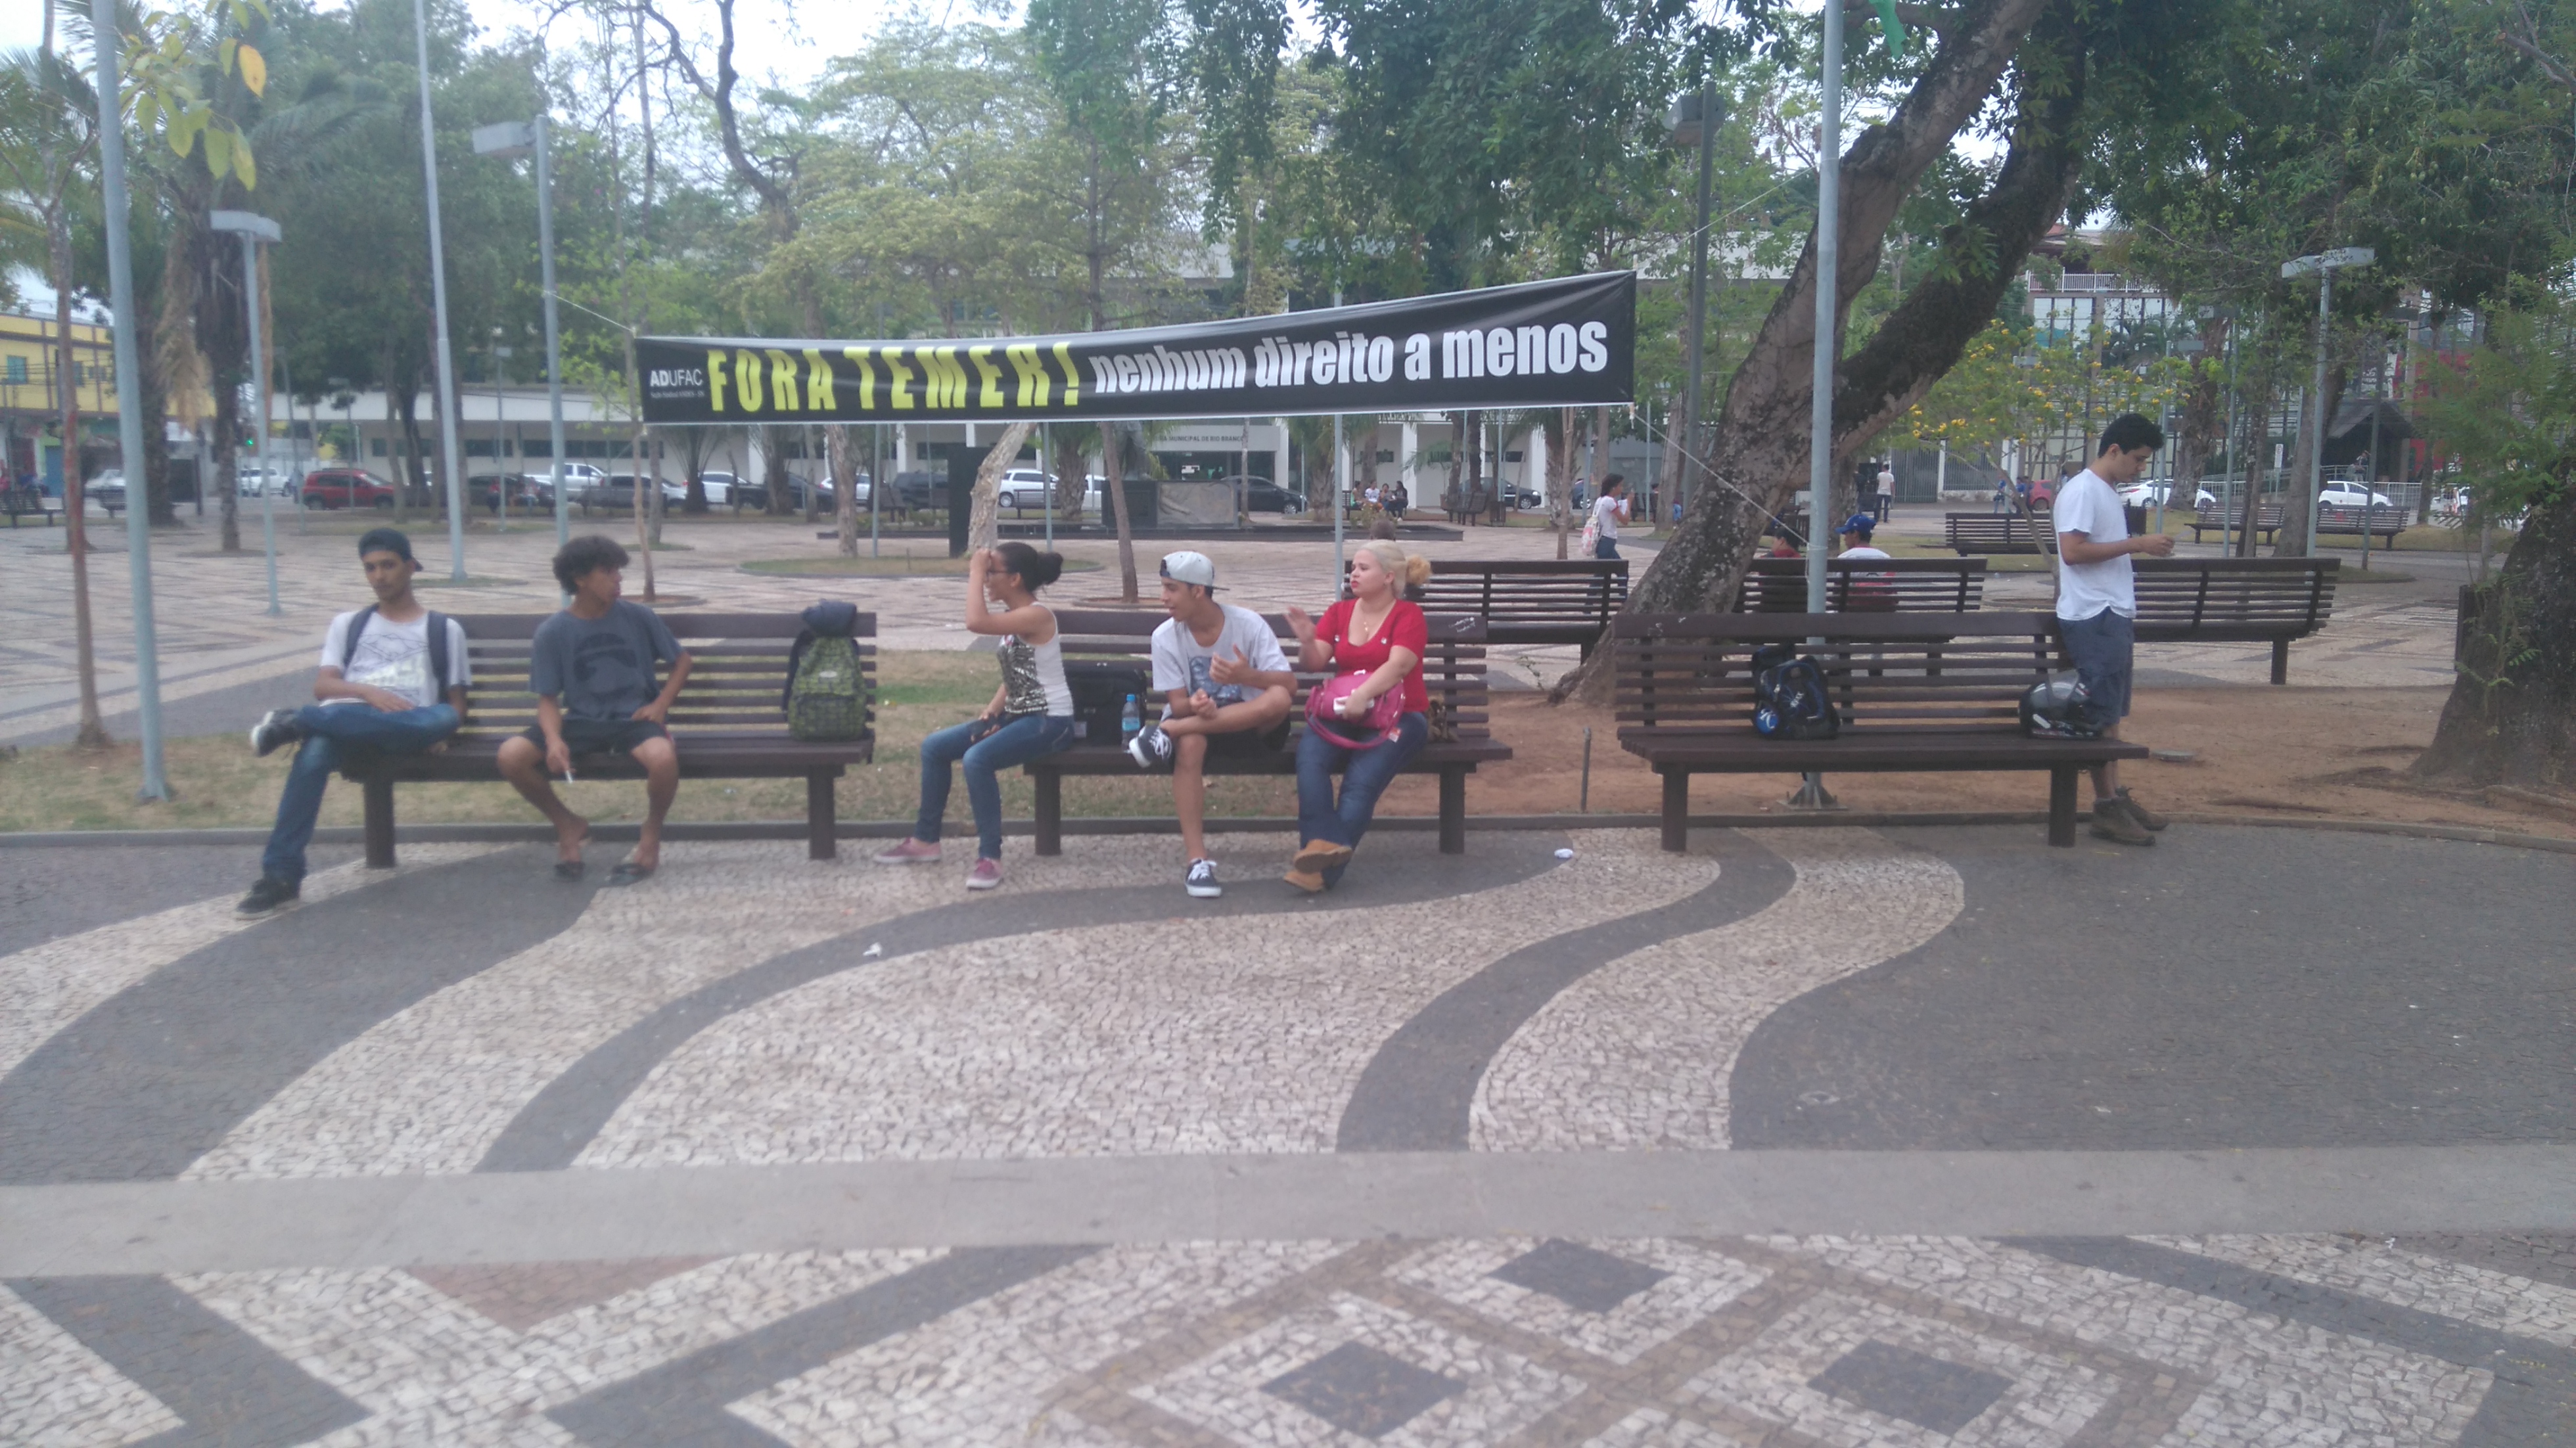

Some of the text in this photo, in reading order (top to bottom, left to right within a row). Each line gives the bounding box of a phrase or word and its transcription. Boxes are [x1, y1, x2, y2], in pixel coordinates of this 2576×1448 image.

[650, 369, 702, 387] ADUFAC
[707, 321, 1609, 413] FORA TEMER! nenhum direito a menos
